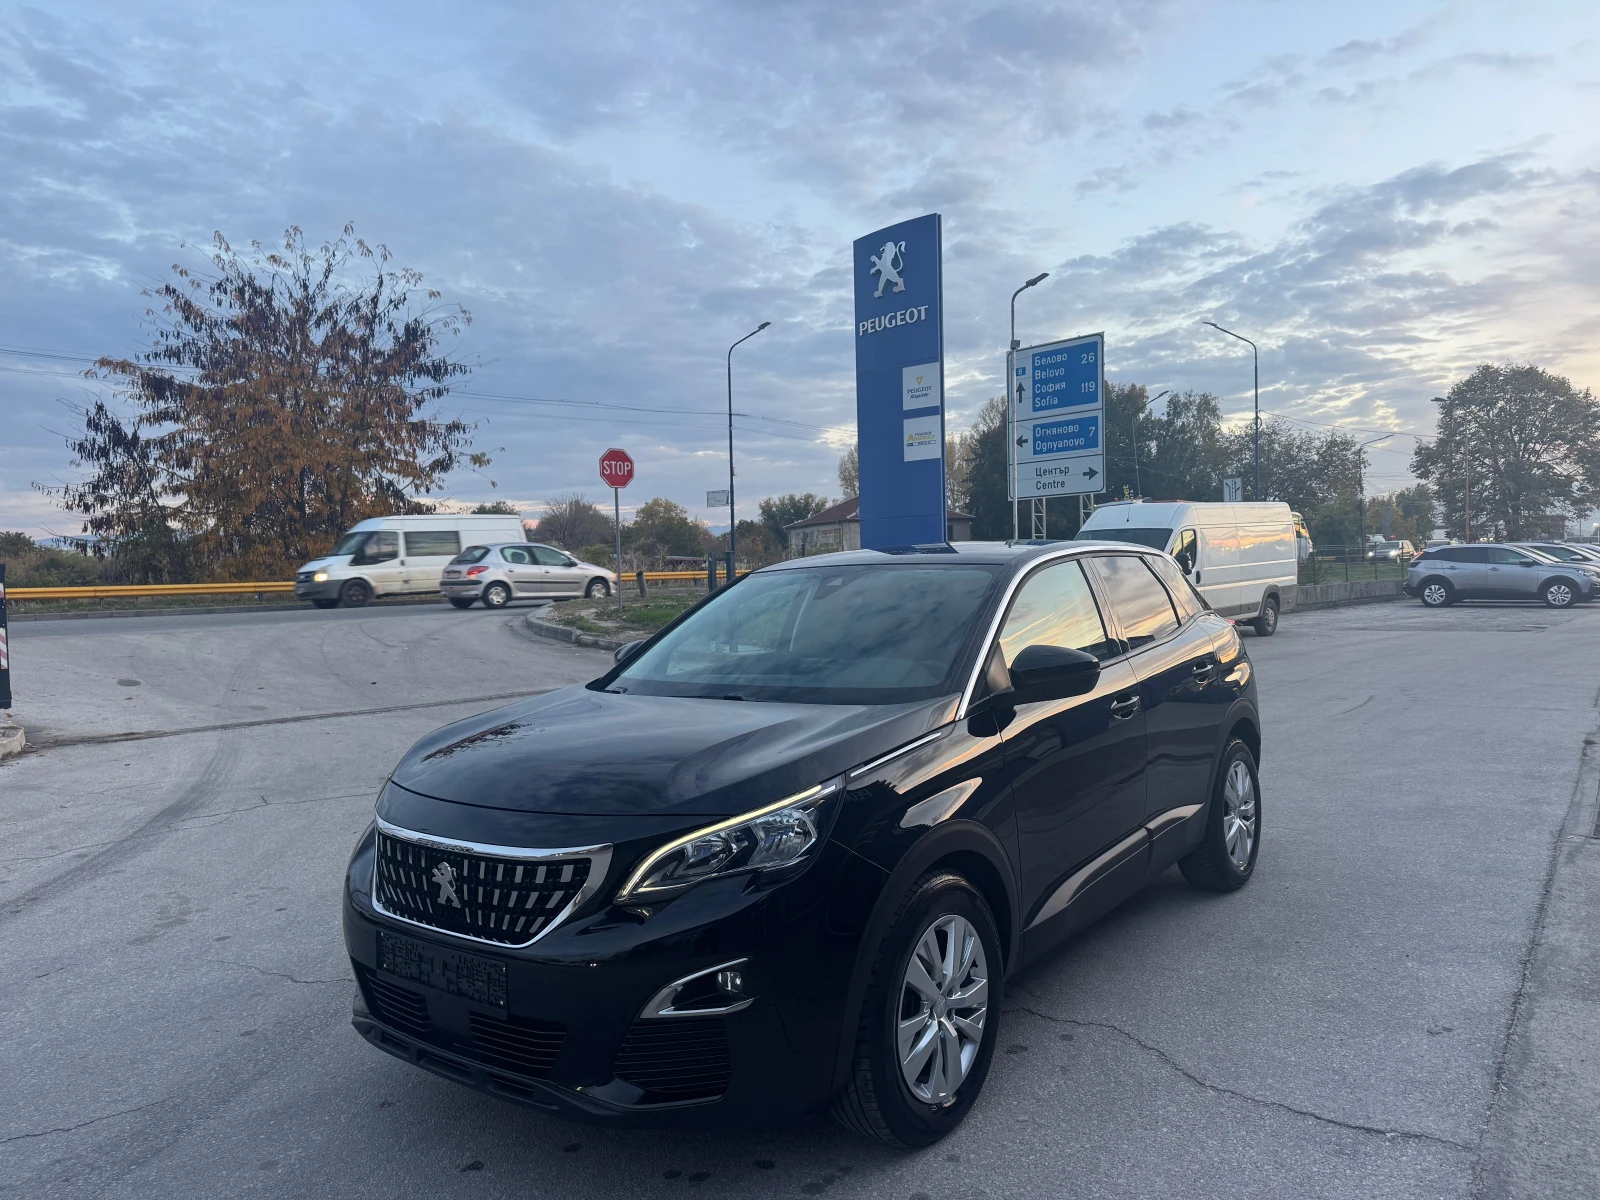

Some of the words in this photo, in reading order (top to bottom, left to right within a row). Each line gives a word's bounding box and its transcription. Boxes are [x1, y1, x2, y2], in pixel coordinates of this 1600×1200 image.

[859, 305, 929, 337] PEUGEOT
[1034, 353, 1068, 366] Белово
[1081, 352, 1095, 364] 26
[1035, 367, 1065, 380] Belovo
[907, 385, 932, 394] PEUGEOT
[1035, 381, 1066, 393] София
[1081, 381, 1096, 393] 119
[1035, 395, 1058, 407] Sofia
[1035, 424, 1079, 437] Огняново
[1089, 426, 1096, 437] 7
[1035, 437, 1085, 452] Ognyanovo
[603, 460, 632, 475] STOP
[1035, 466, 1070, 478] Център
[1035, 479, 1066, 490] Centre
